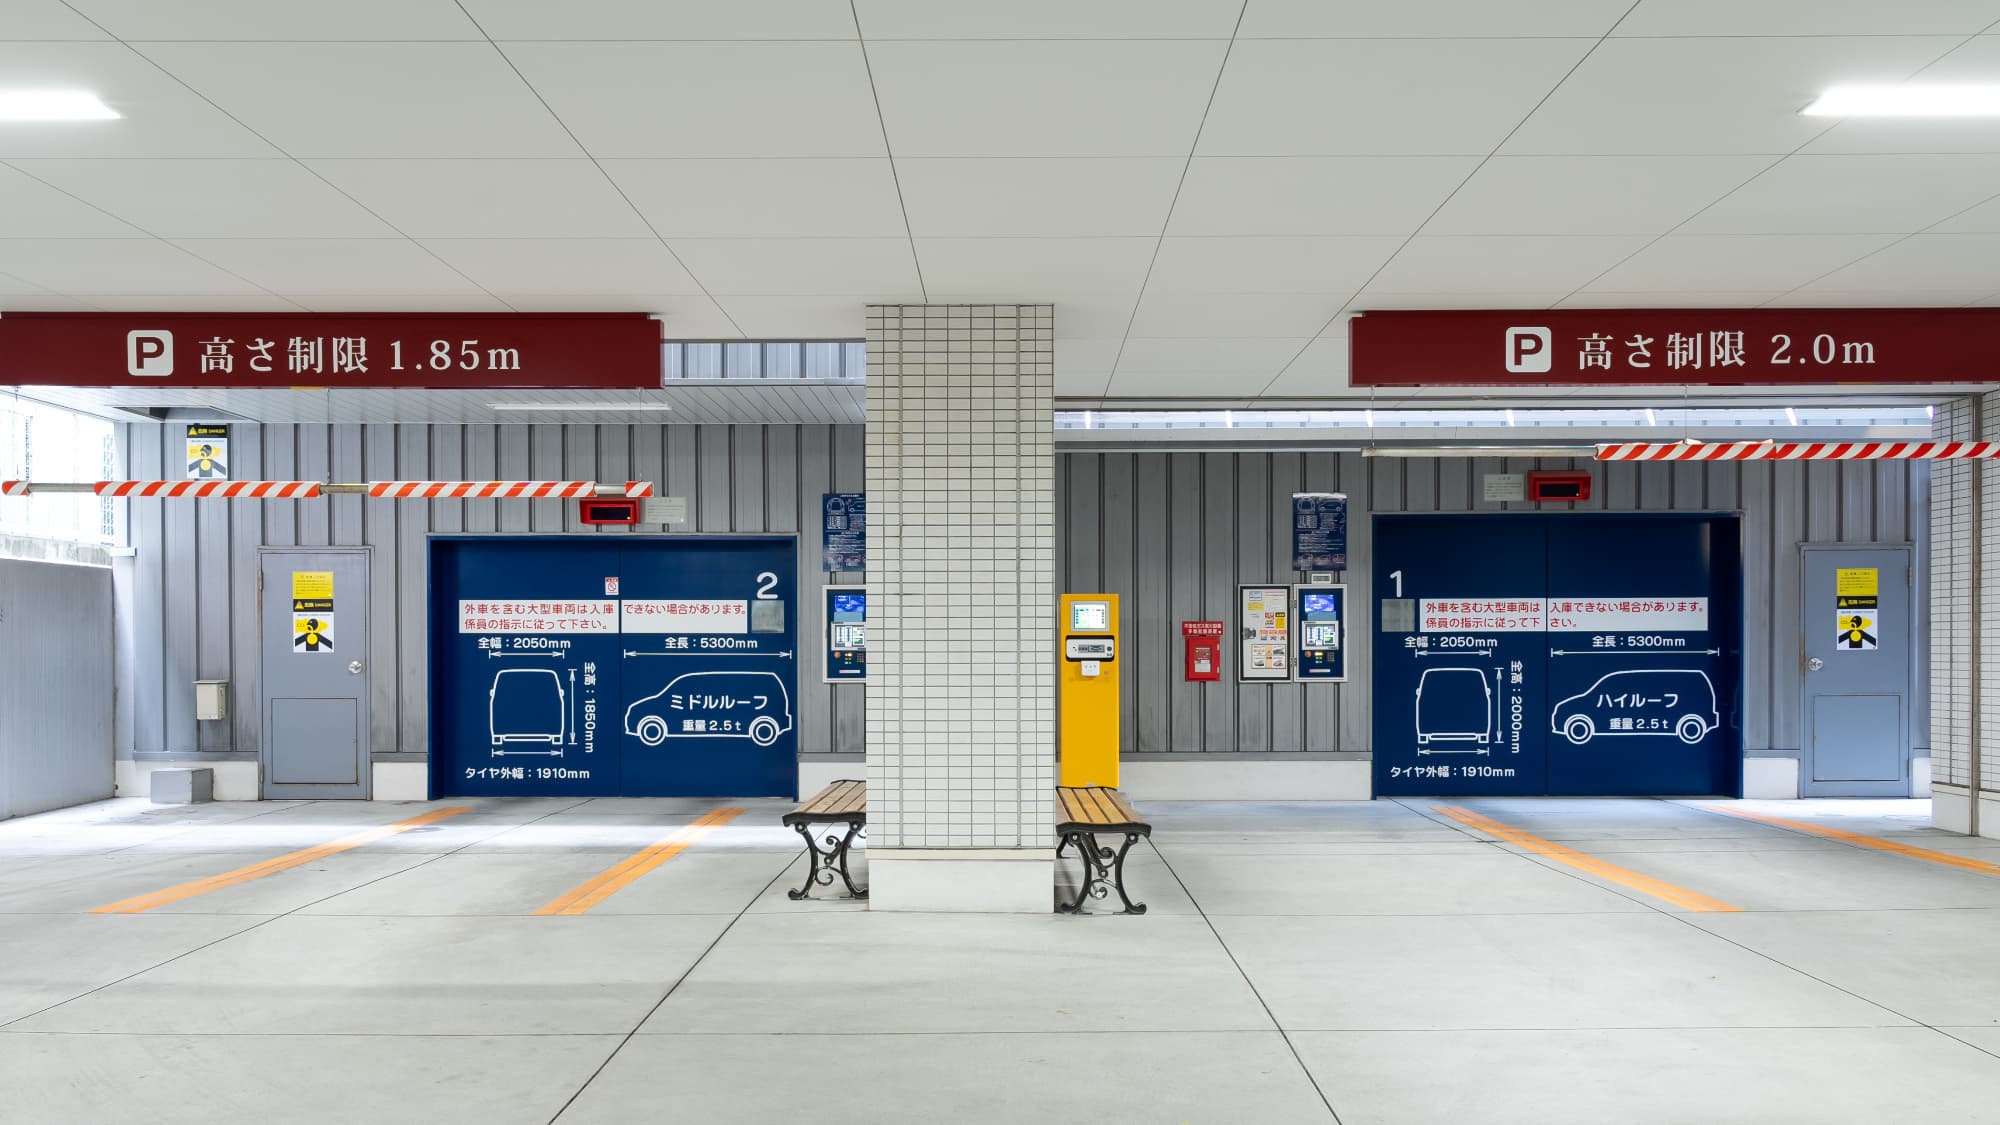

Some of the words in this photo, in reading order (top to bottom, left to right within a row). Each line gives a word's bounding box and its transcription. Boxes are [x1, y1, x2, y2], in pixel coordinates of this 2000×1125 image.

[135, 336, 165, 370] P
[198, 336, 369, 374] 高さ制限
[390, 339, 521, 371] 1.85m
[1514, 333, 1544, 366] P
[1577, 331, 1746, 370] 高さ制限
[1770, 334, 1876, 365] 2.0m
[756, 571, 779, 600] 2
[1389, 570, 1403, 598] 1
[464, 618, 608, 630] 係員の指示に従って下さい。
[670, 694, 768, 710] ミドルルーフ
[1596, 692, 1679, 709] ハイルーフ
